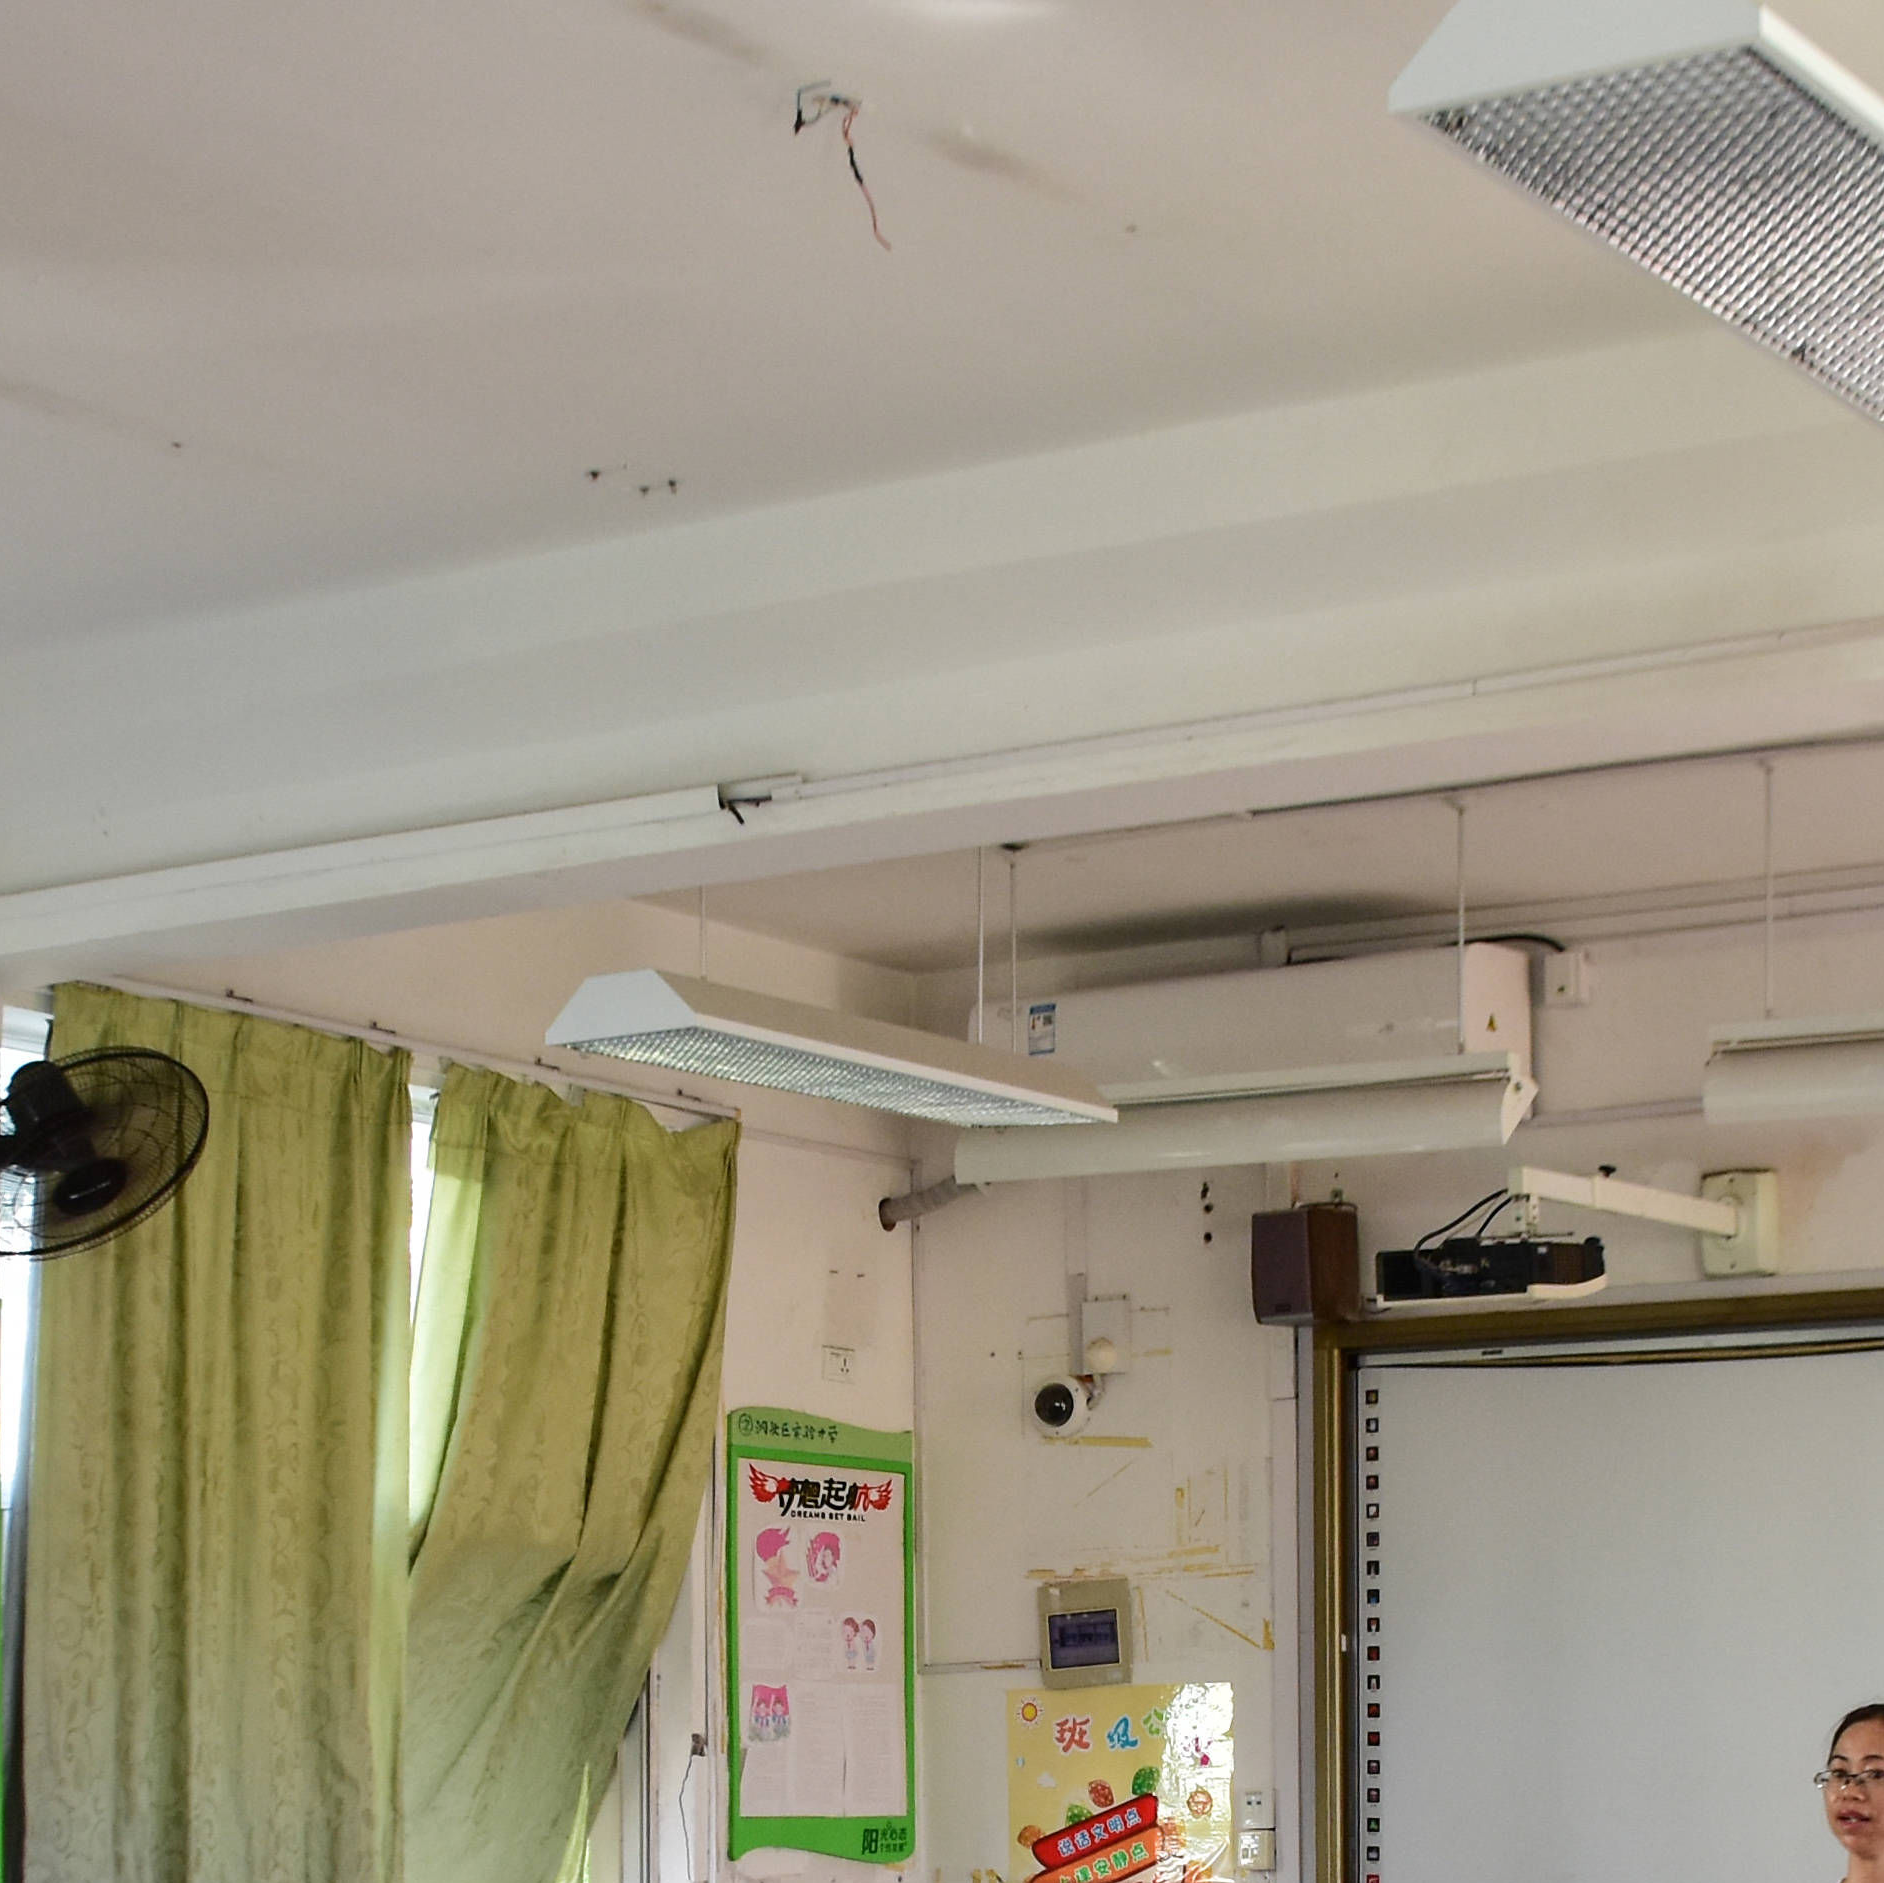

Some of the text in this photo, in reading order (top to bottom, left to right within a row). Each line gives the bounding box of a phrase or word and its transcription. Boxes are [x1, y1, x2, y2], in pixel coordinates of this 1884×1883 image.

[1058, 1808, 1142, 1858] 说话文明点
